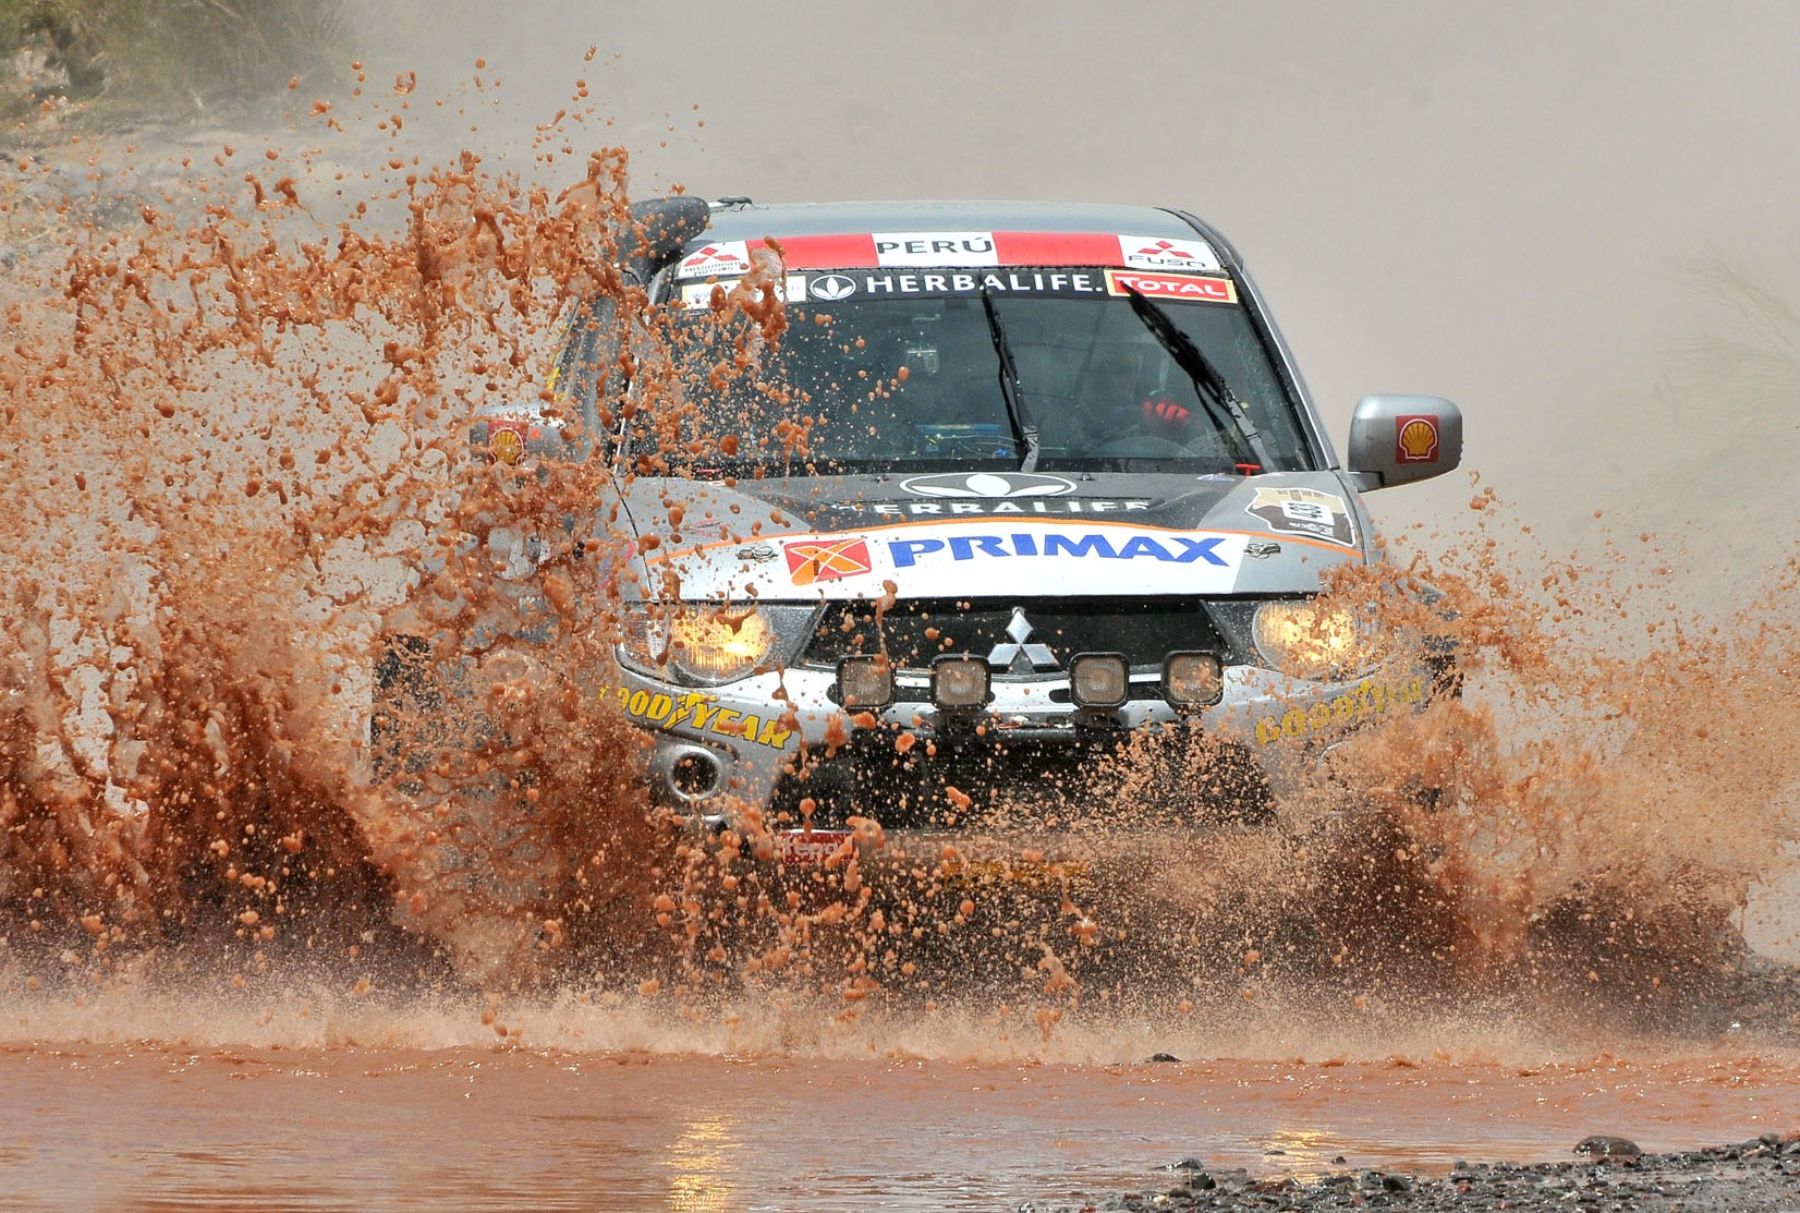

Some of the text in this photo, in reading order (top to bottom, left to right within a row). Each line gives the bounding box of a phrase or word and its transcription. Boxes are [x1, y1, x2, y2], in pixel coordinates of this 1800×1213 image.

[876, 236, 993, 254] PERÚ
[1128, 254, 1206, 268] FUSO
[1115, 276, 1226, 296] TOTAL
[888, 534, 1230, 568] PRIMAX
